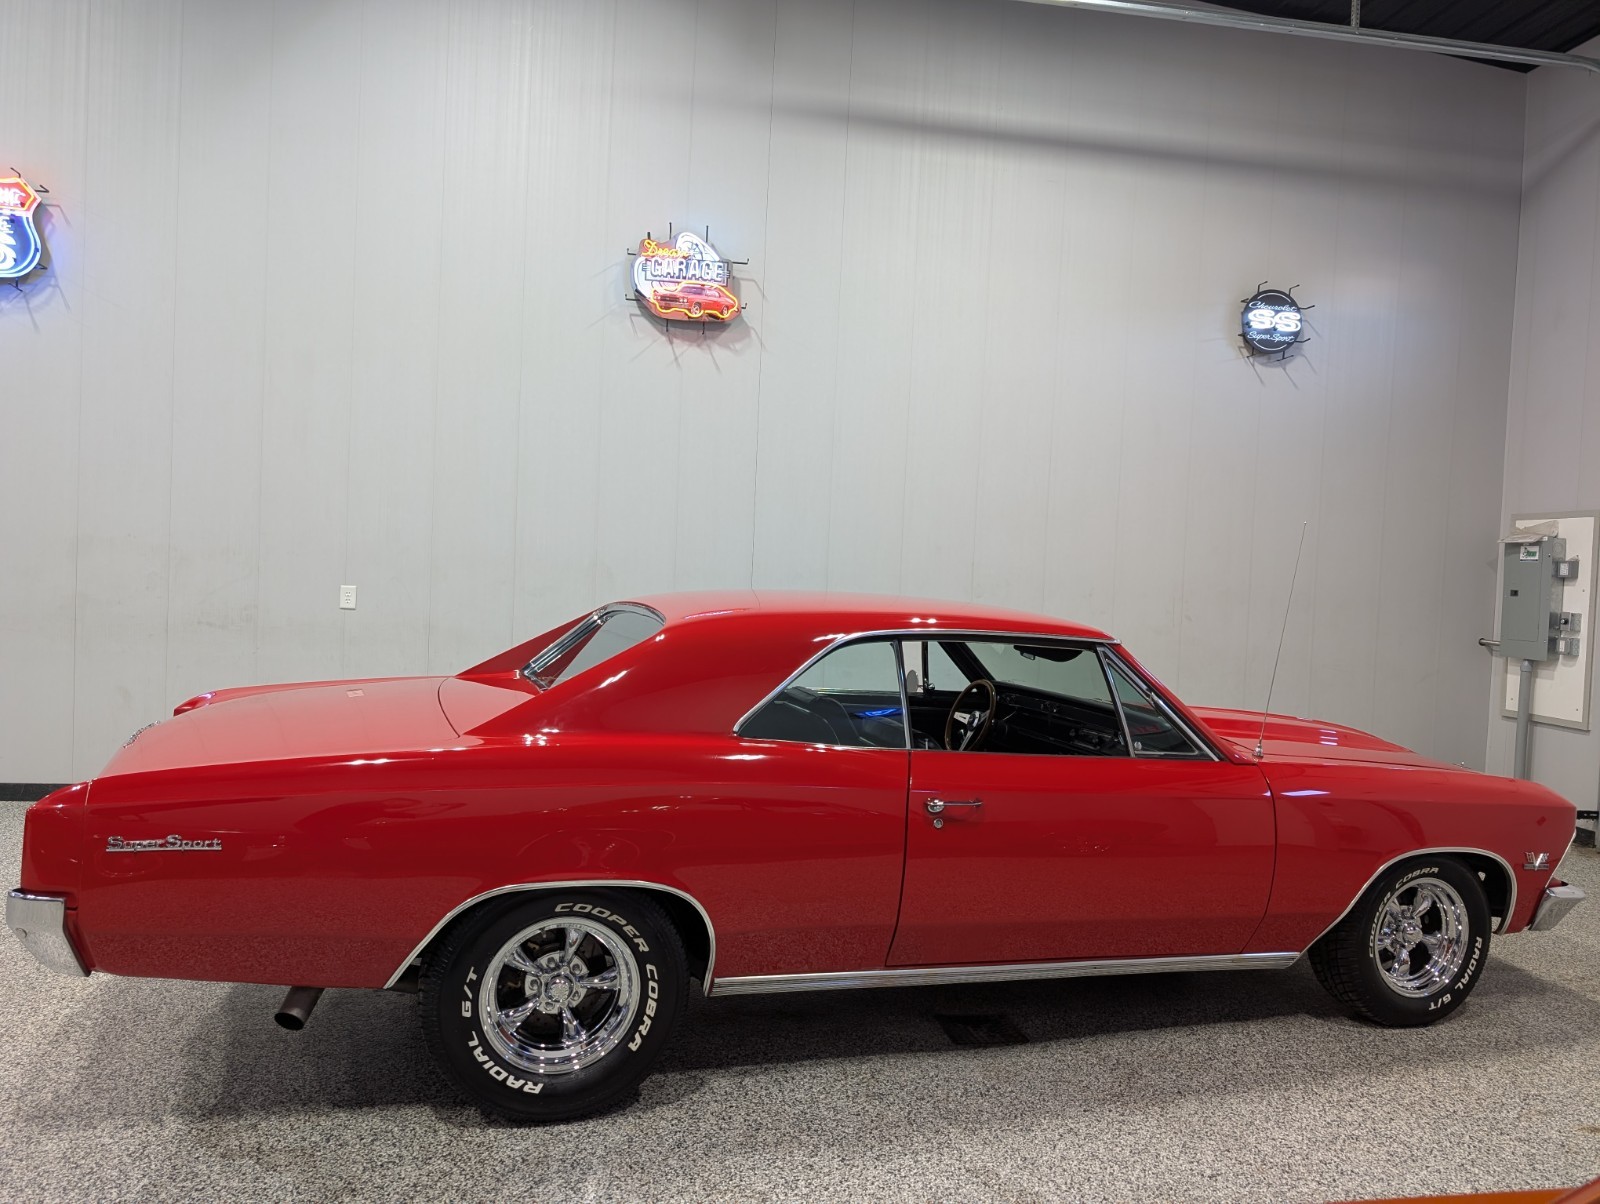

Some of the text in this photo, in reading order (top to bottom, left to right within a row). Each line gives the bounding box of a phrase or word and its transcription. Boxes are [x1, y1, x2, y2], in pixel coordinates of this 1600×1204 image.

[651, 258, 724, 281] GARAGE
[1249, 301, 1297, 312] Chevrolet
[1248, 309, 1301, 332] SS
[1247, 331, 1295, 343] Super Sport
[107, 834, 222, 852] Super Sport
[1395, 867, 1439, 889] COBRA
[554, 902, 658, 1052] COOPER COBRA
[1429, 936, 1482, 1011] RADIAL G/T
[461, 966, 544, 1095] RADIAL G/T
